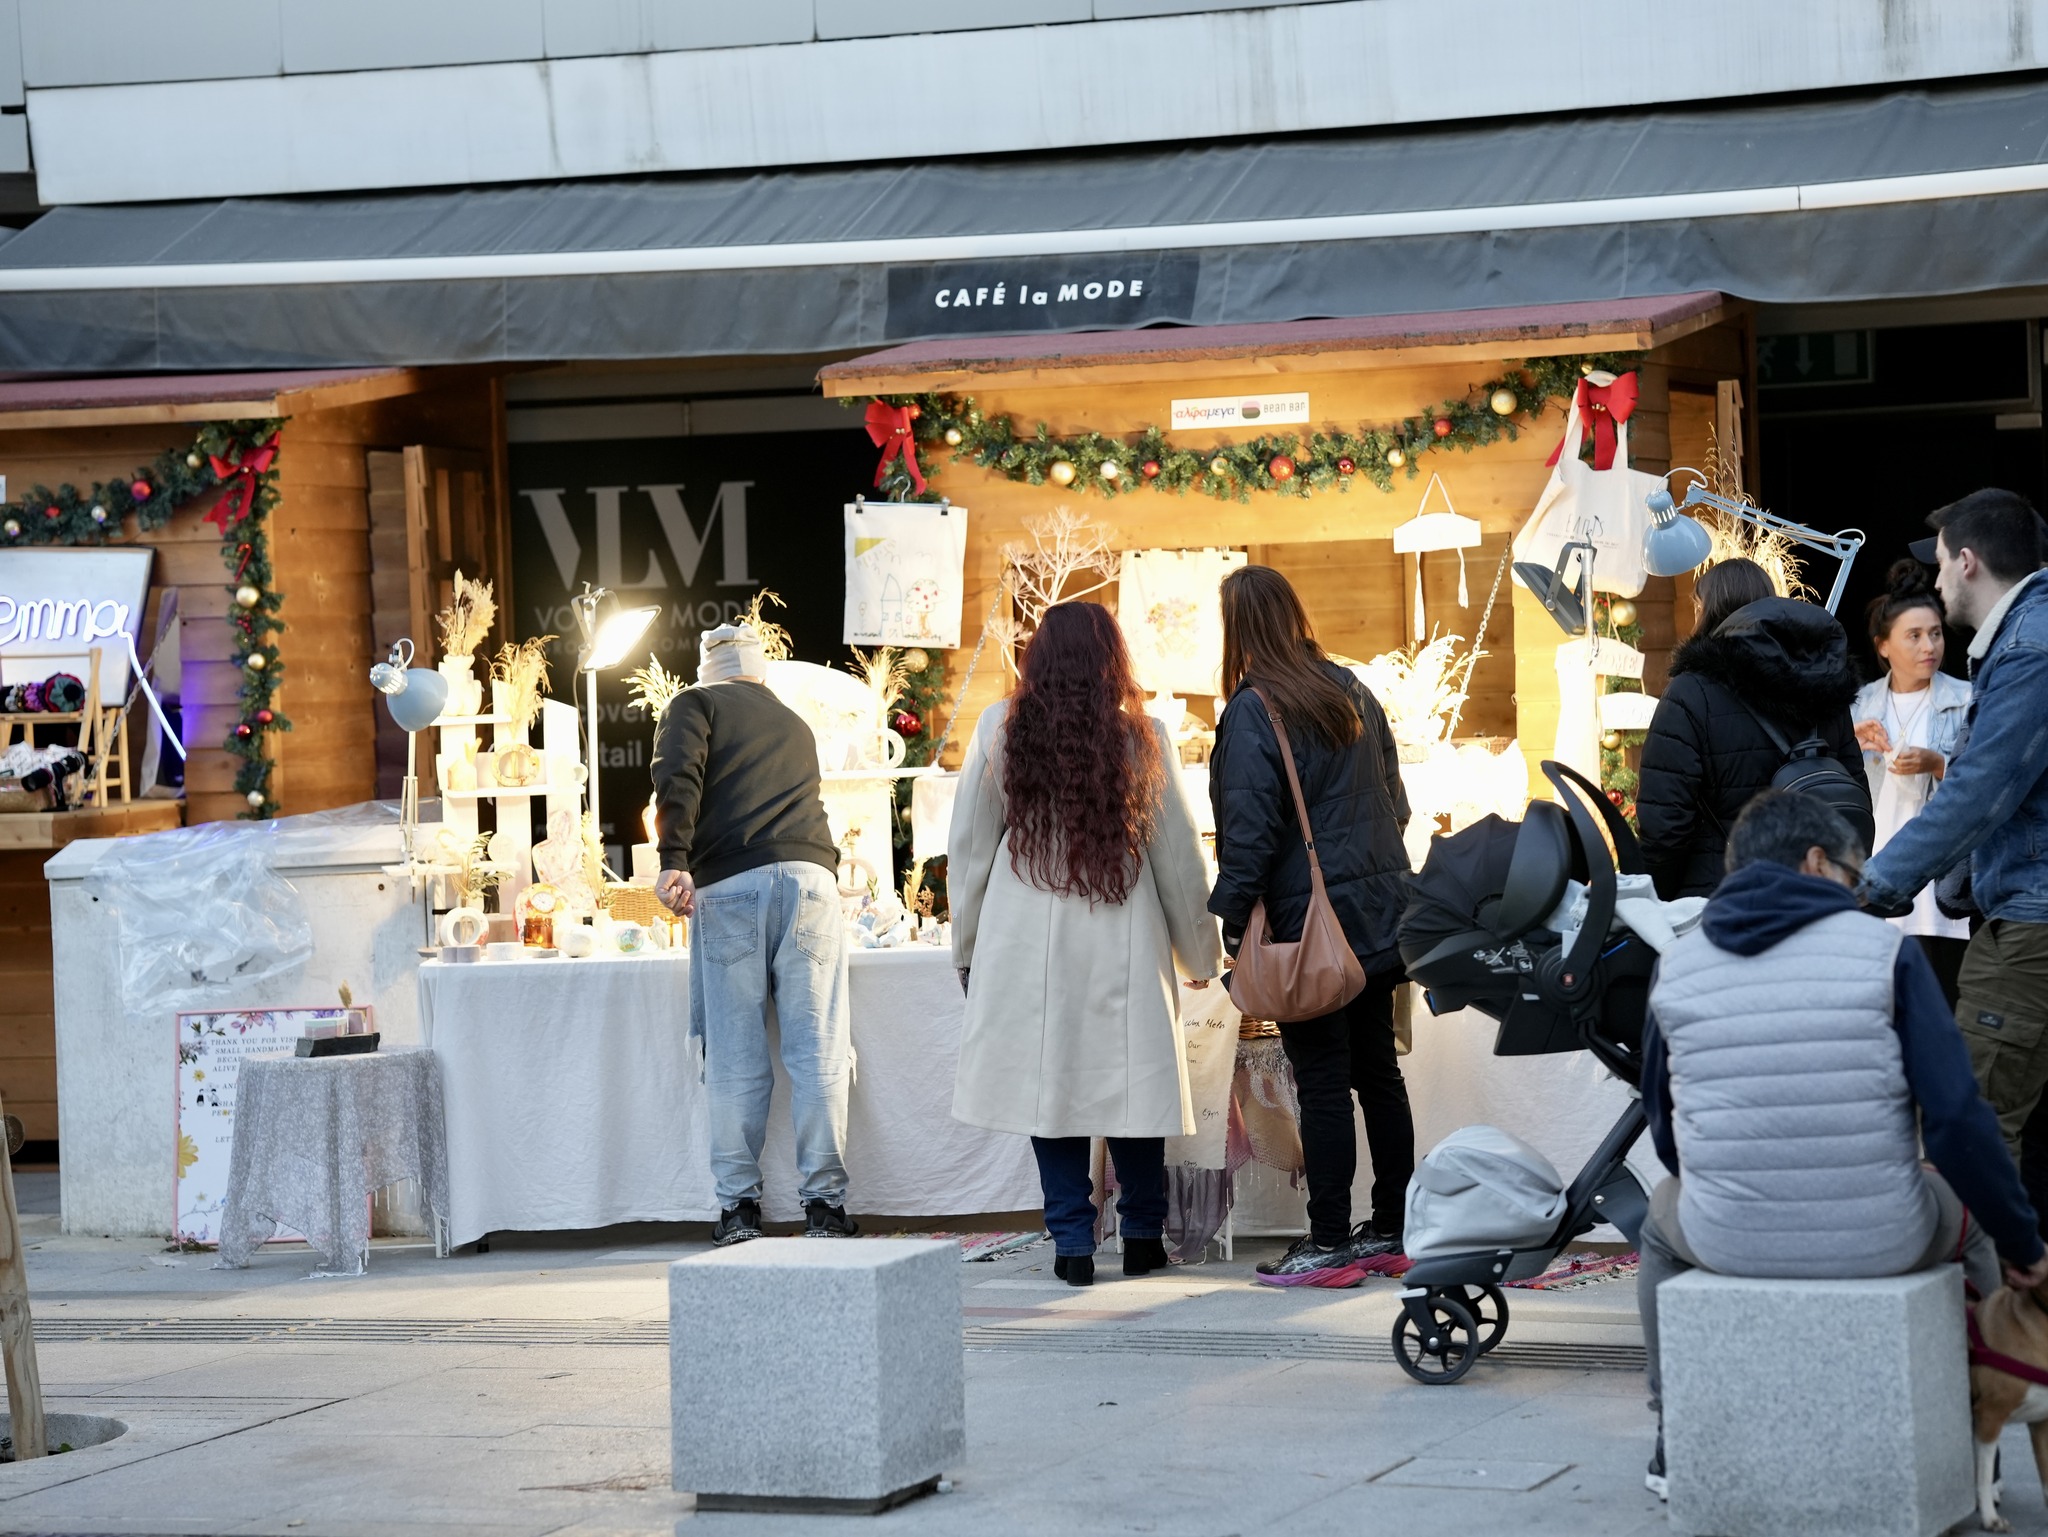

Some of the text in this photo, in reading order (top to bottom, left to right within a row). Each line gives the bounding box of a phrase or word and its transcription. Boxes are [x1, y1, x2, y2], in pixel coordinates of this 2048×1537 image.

[935, 280, 1143, 308] CAFÉ la MODE
[518, 481, 759, 592] VLM
